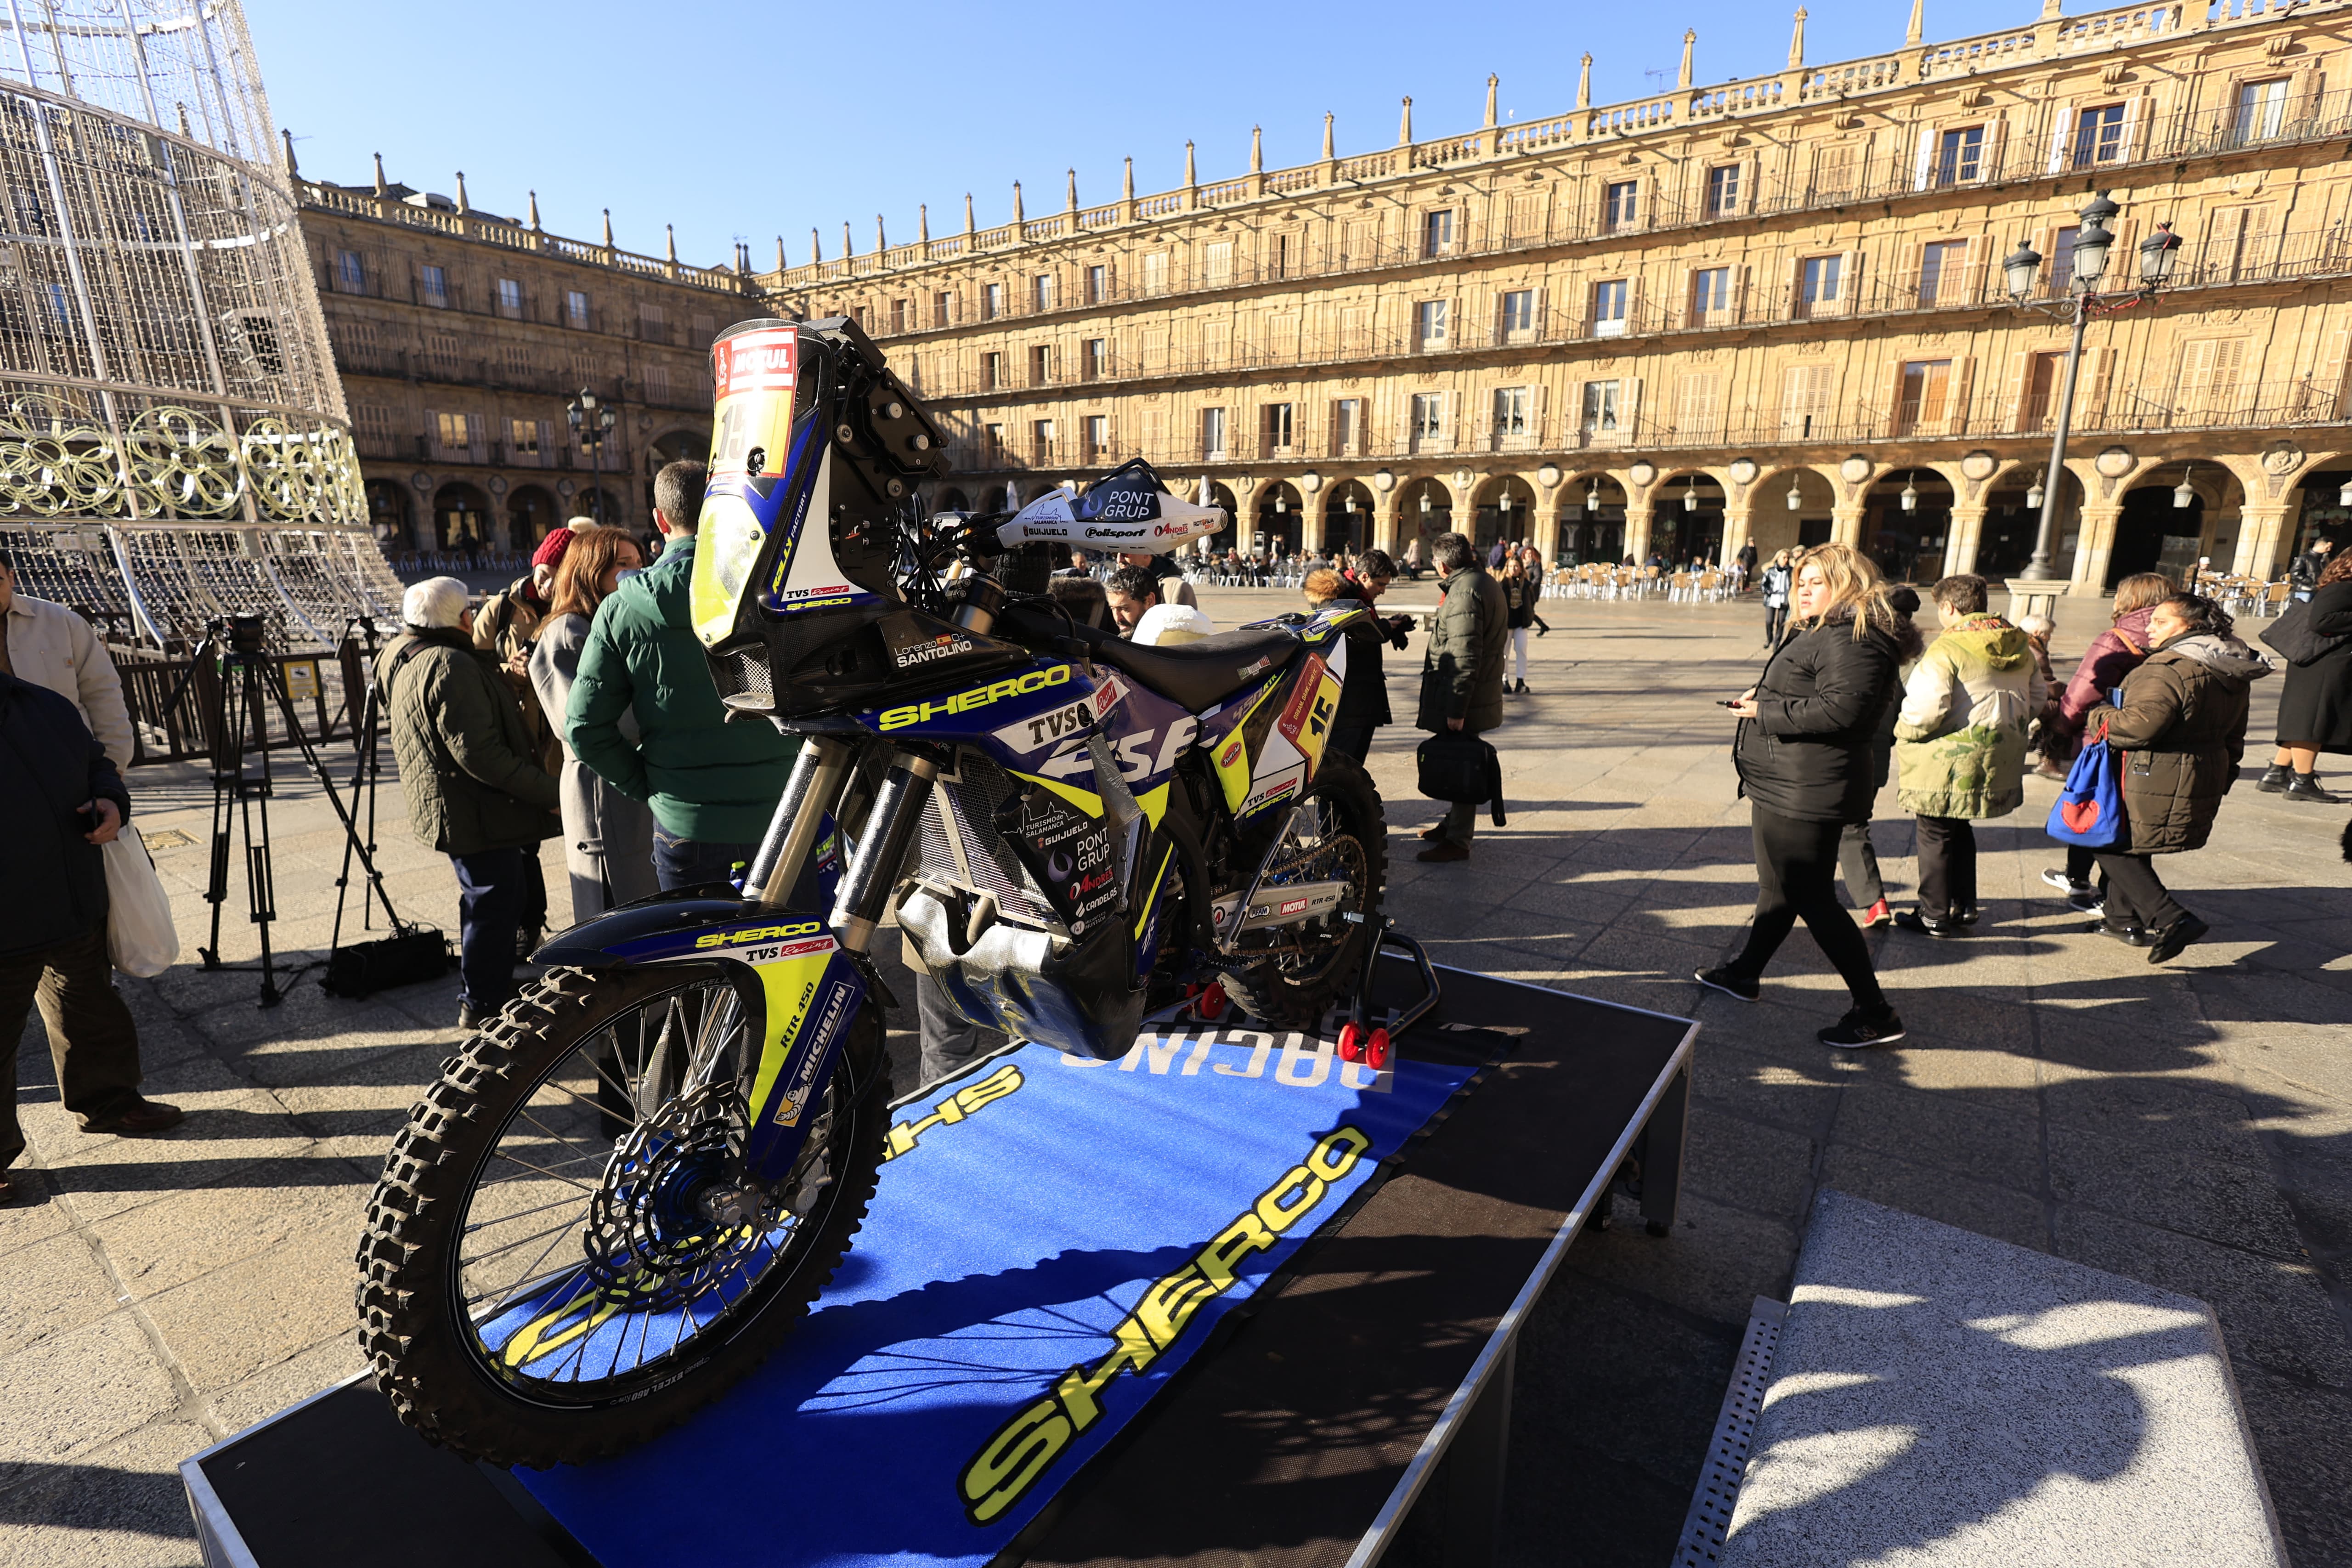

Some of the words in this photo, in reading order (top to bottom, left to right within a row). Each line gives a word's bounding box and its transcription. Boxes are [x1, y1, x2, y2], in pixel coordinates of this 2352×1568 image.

[733, 348, 790, 374] MOTUL
[1108, 491, 1154, 505] PONT
[1104, 504, 1150, 519] GRUP
[772, 537, 792, 594] RALLY
[791, 491, 807, 538] FACTORY
[1086, 527, 1146, 538] Polisport
[786, 589, 809, 598] TVS
[812, 586, 849, 596] Racing
[786, 598, 852, 611] SHERCO
[1312, 621, 1330, 632] MICHELIN
[894, 641, 937, 656] Lorenzo
[897, 640, 972, 668] SANTOLINO
[1263, 674, 1277, 693] RTR
[879, 664, 1070, 731] SHERCO
[1294, 699, 1305, 720] DREAM.
[1301, 685, 1310, 702] DARE.
[1028, 707, 1077, 745] TVS
[1098, 683, 1114, 713] Racing
[1310, 695, 1334, 736] 15
[1223, 750, 1235, 766] Twin
[1246, 790, 1294, 818] SHERCO
[1248, 792, 1265, 807] TVS
[1266, 779, 1297, 797] Racing
[1025, 821, 1064, 838] SALAMANCA
[1045, 821, 1088, 846] GUIJUELO
[1077, 827, 1108, 856] PONT
[1078, 843, 1110, 872] GRUP
[1079, 868, 1114, 895] ANDRES
[1086, 887, 1117, 911] CANDELAS
[1282, 900, 1306, 914] MOTUL
[1085, 916, 1106, 930] MUNTADA
[1252, 906, 1268, 917] AFAM
[695, 922, 820, 949] SHERCO
[746, 946, 779, 962] TVS
[782, 938, 832, 957] Racing
[688, 978, 720, 990] EXCEL
[780, 1016, 801, 1049] RTR
[798, 981, 814, 1013] 450
[800, 986, 847, 1082] MICHELIN
[961, 1126, 1371, 1523] SHERCO
[651, 1370, 684, 1393] EXCEL
